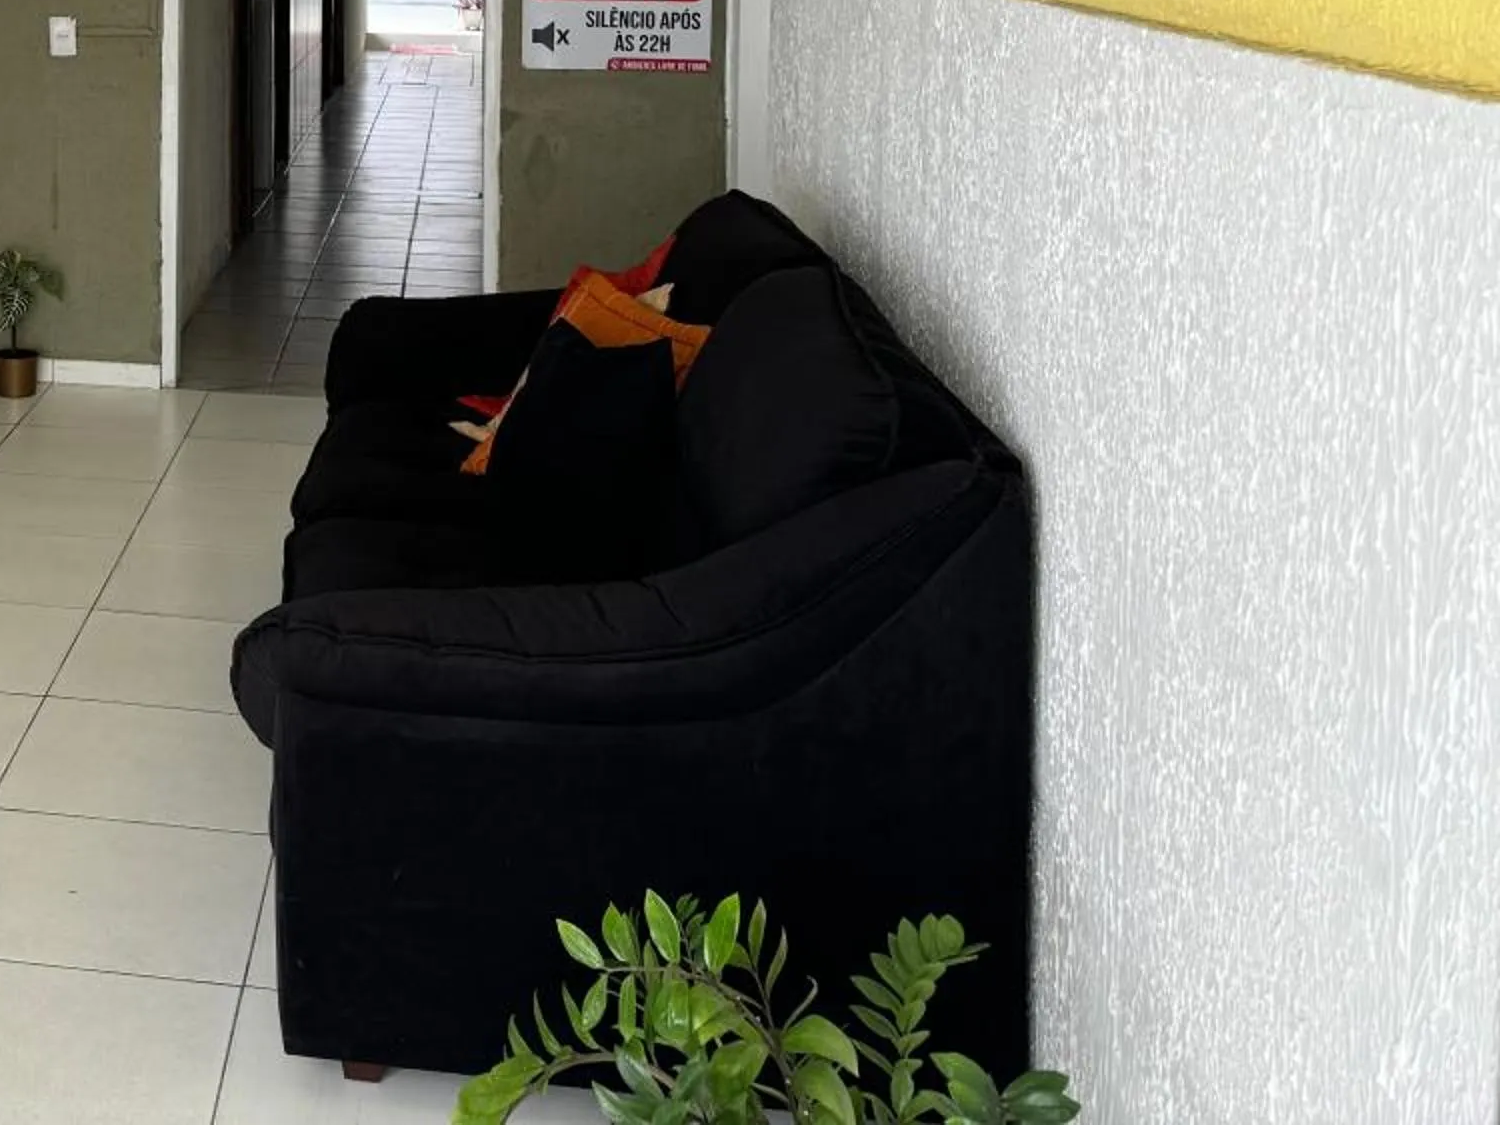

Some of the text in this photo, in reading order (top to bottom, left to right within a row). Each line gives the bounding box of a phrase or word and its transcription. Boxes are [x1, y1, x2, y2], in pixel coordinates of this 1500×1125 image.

[585, 6, 701, 30] SILÊNCIO APÓS
[613, 31, 671, 52] ÀS 22H
